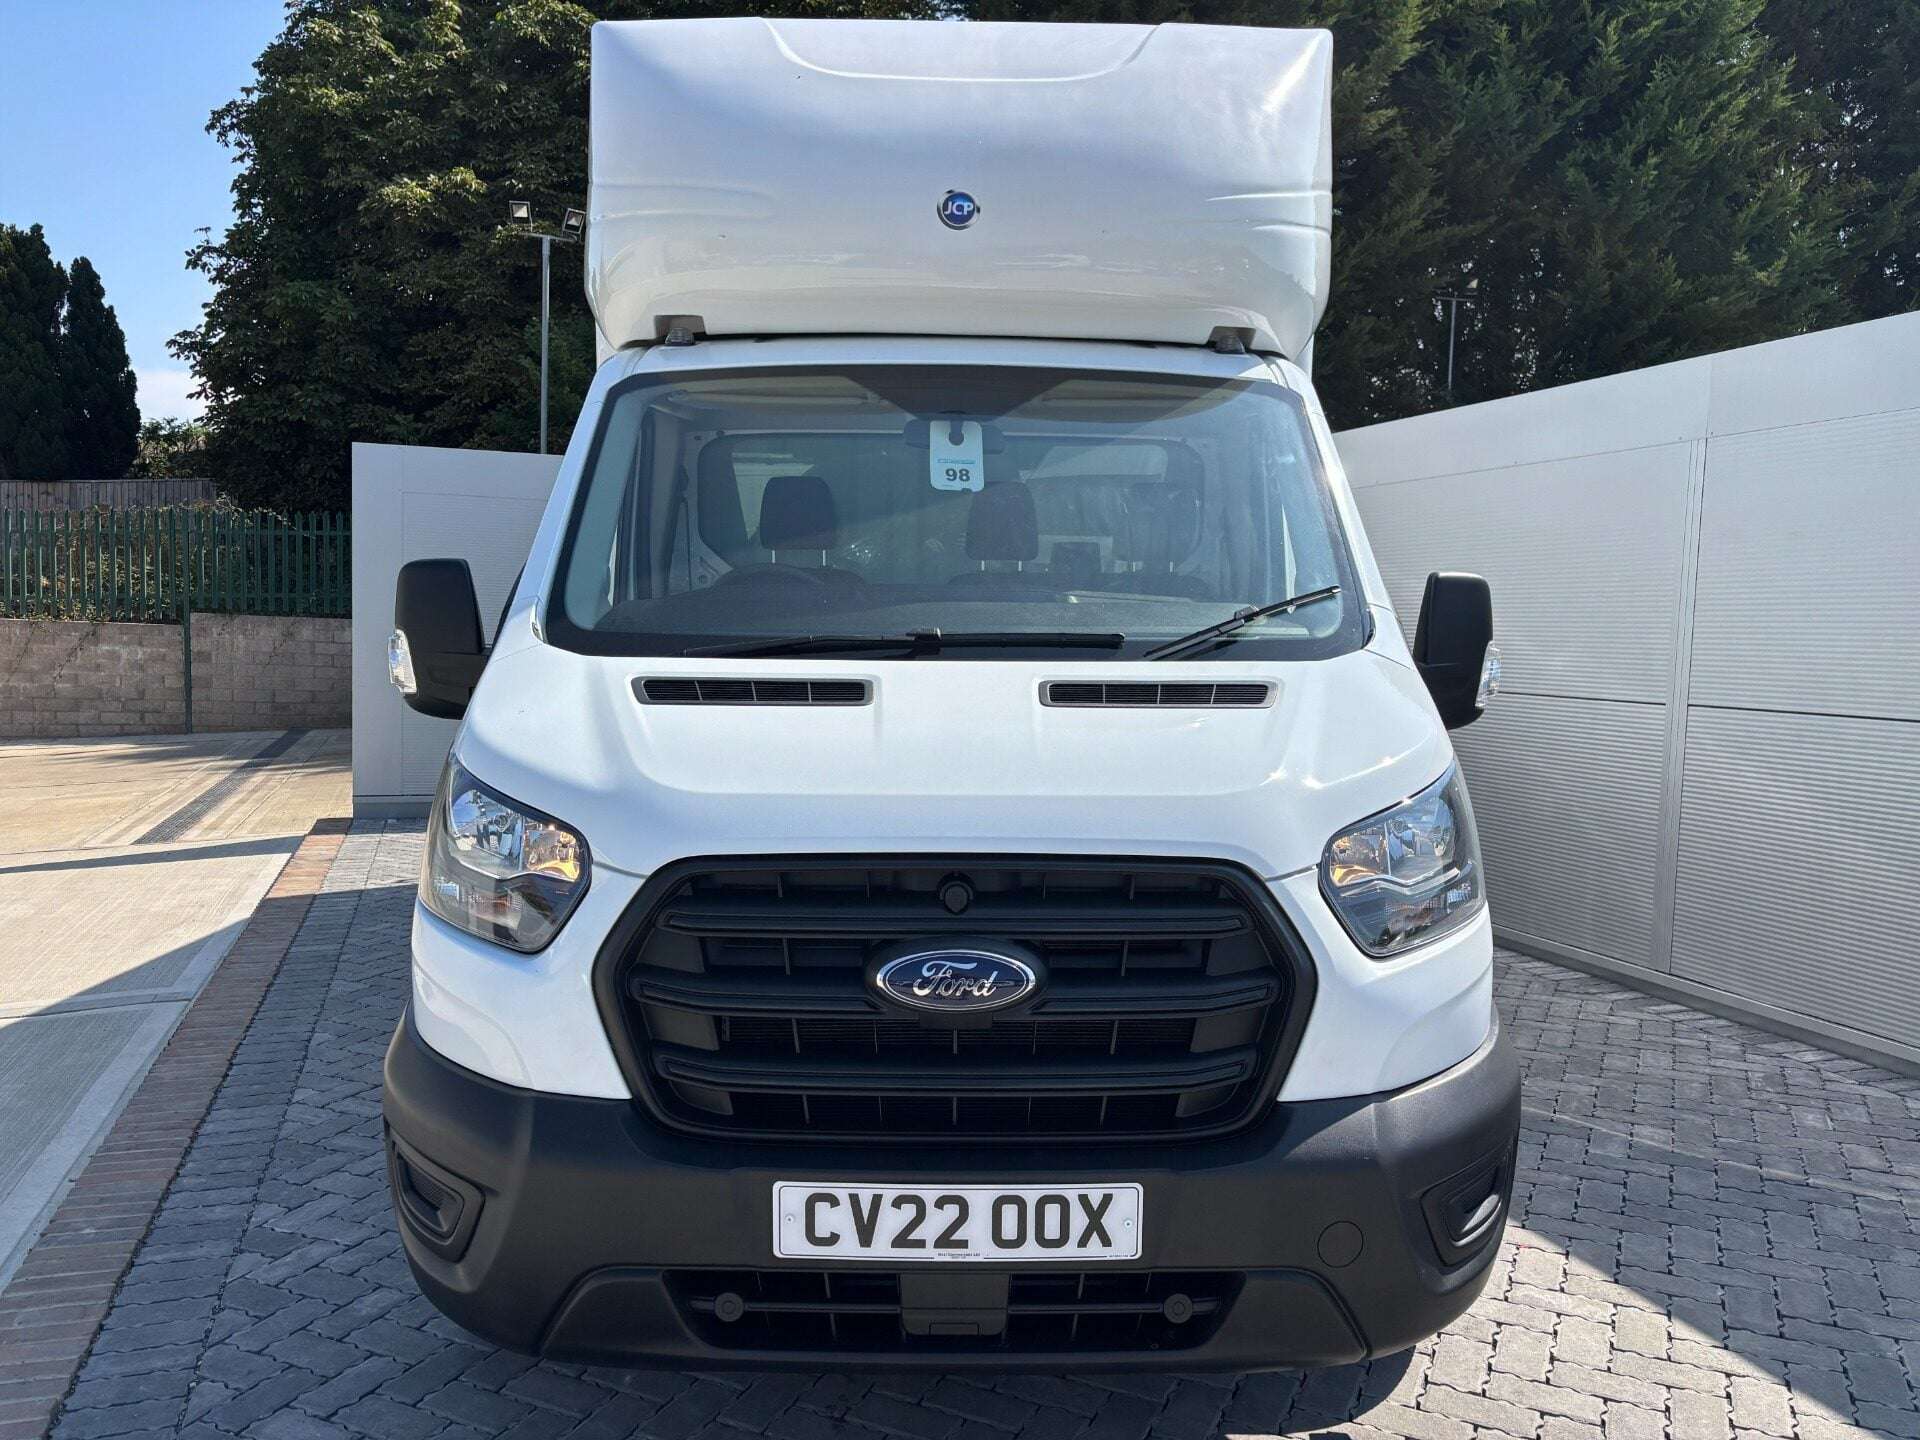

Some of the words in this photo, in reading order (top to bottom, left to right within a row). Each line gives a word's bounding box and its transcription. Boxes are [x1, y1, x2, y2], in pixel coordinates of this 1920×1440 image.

[943, 200, 974, 215] JCP
[945, 468, 971, 482] 98
[912, 960, 998, 997] Ford
[804, 1192, 969, 1249] CV22
[991, 1193, 1114, 1250] OOX
